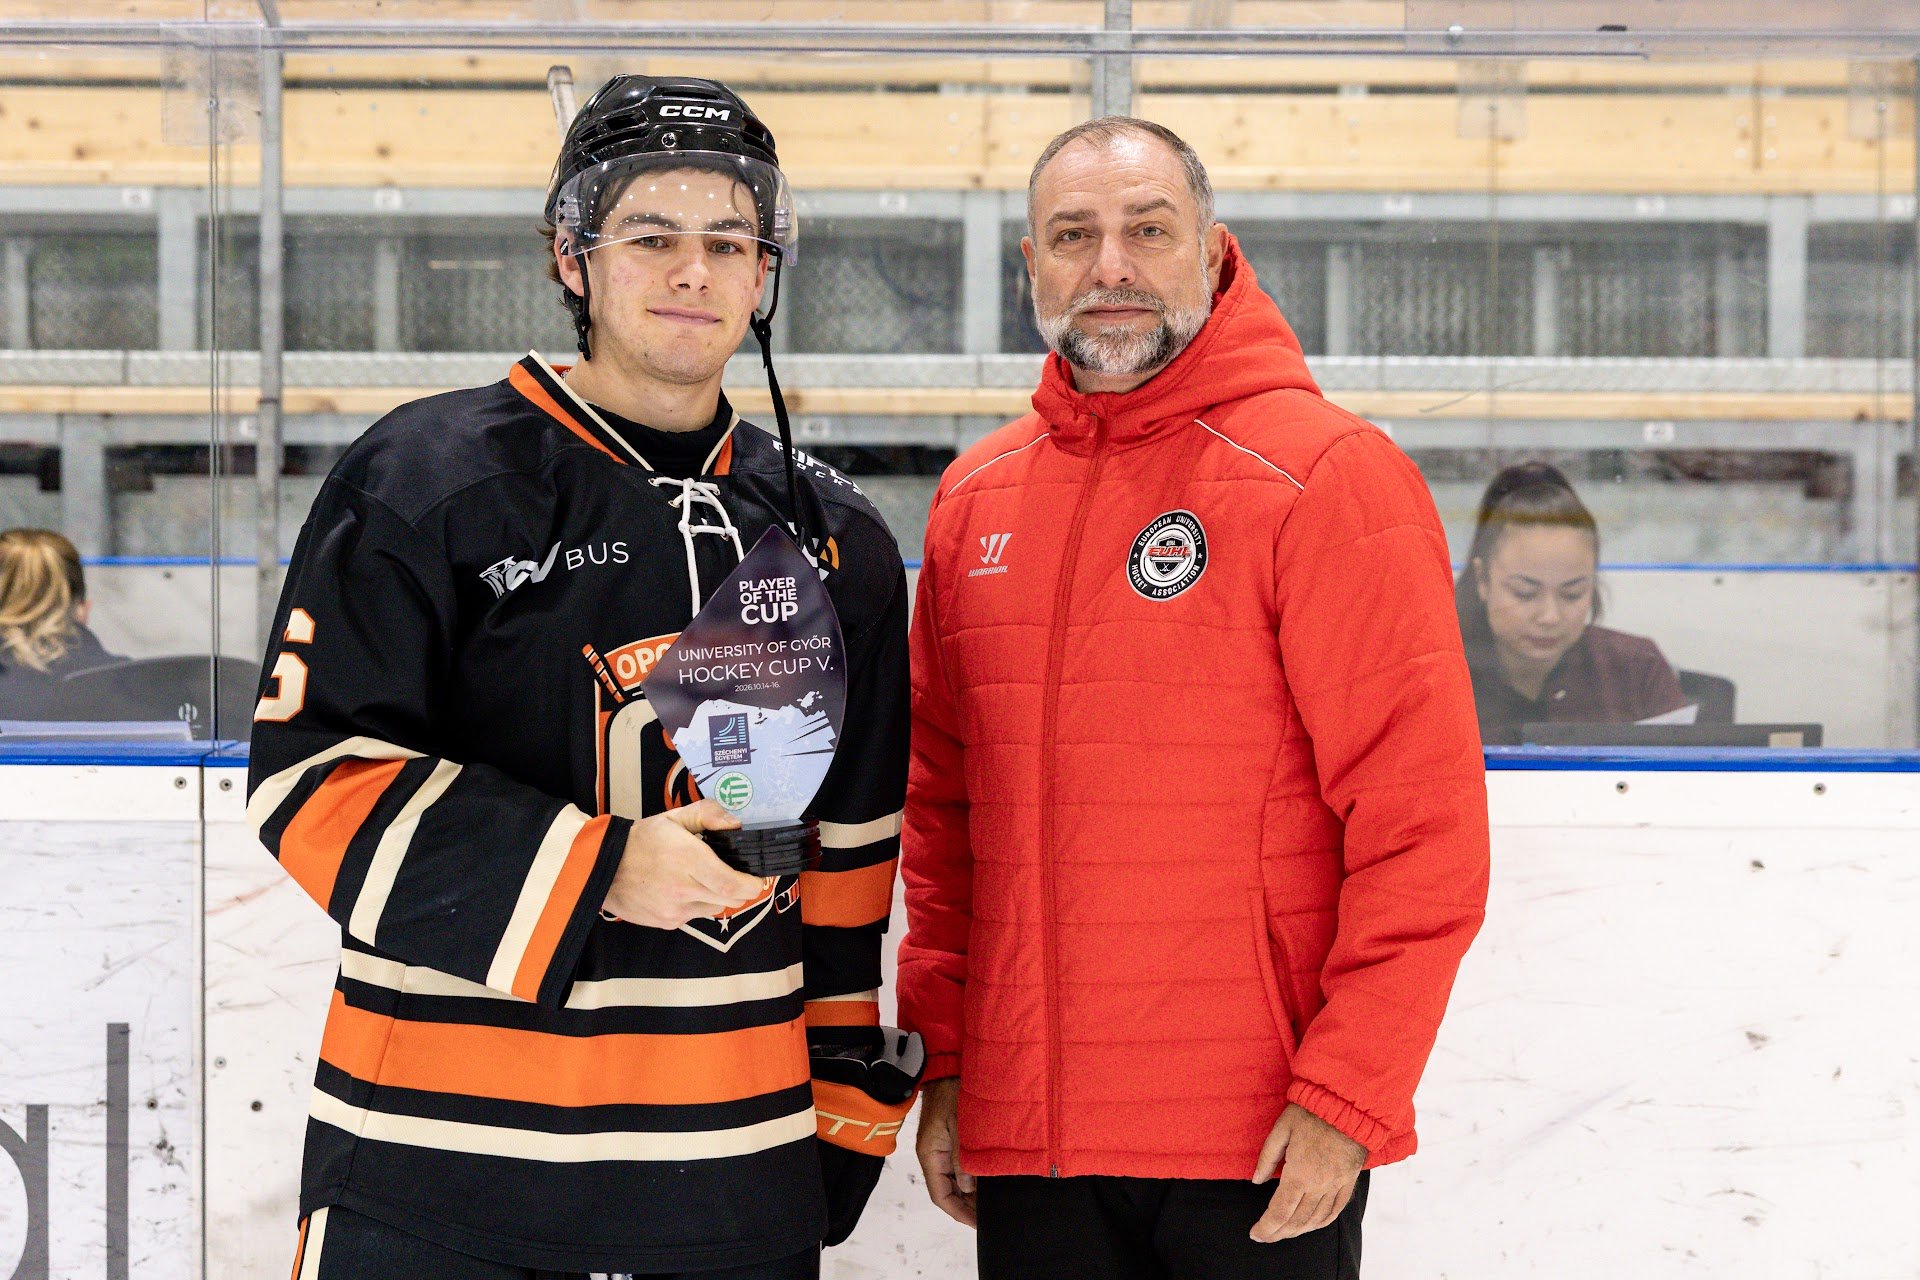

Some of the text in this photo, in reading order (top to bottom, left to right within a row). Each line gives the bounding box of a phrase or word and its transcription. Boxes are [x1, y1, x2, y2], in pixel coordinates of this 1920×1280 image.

[659, 105, 731, 121] CCM
[1138, 515, 1202, 546] EUROPEAN UNIVERSITY
[565, 541, 629, 571] BUS
[739, 576, 796, 592] PLAYER
[1131, 564, 1200, 596] HOCKEY ASSOCIATION
[740, 588, 798, 605] OF THE
[741, 601, 799, 625] CUP
[678, 635, 832, 662] UNIVERSITY OF GYŐR
[679, 655, 834, 684] HOCKEY CUP V.
